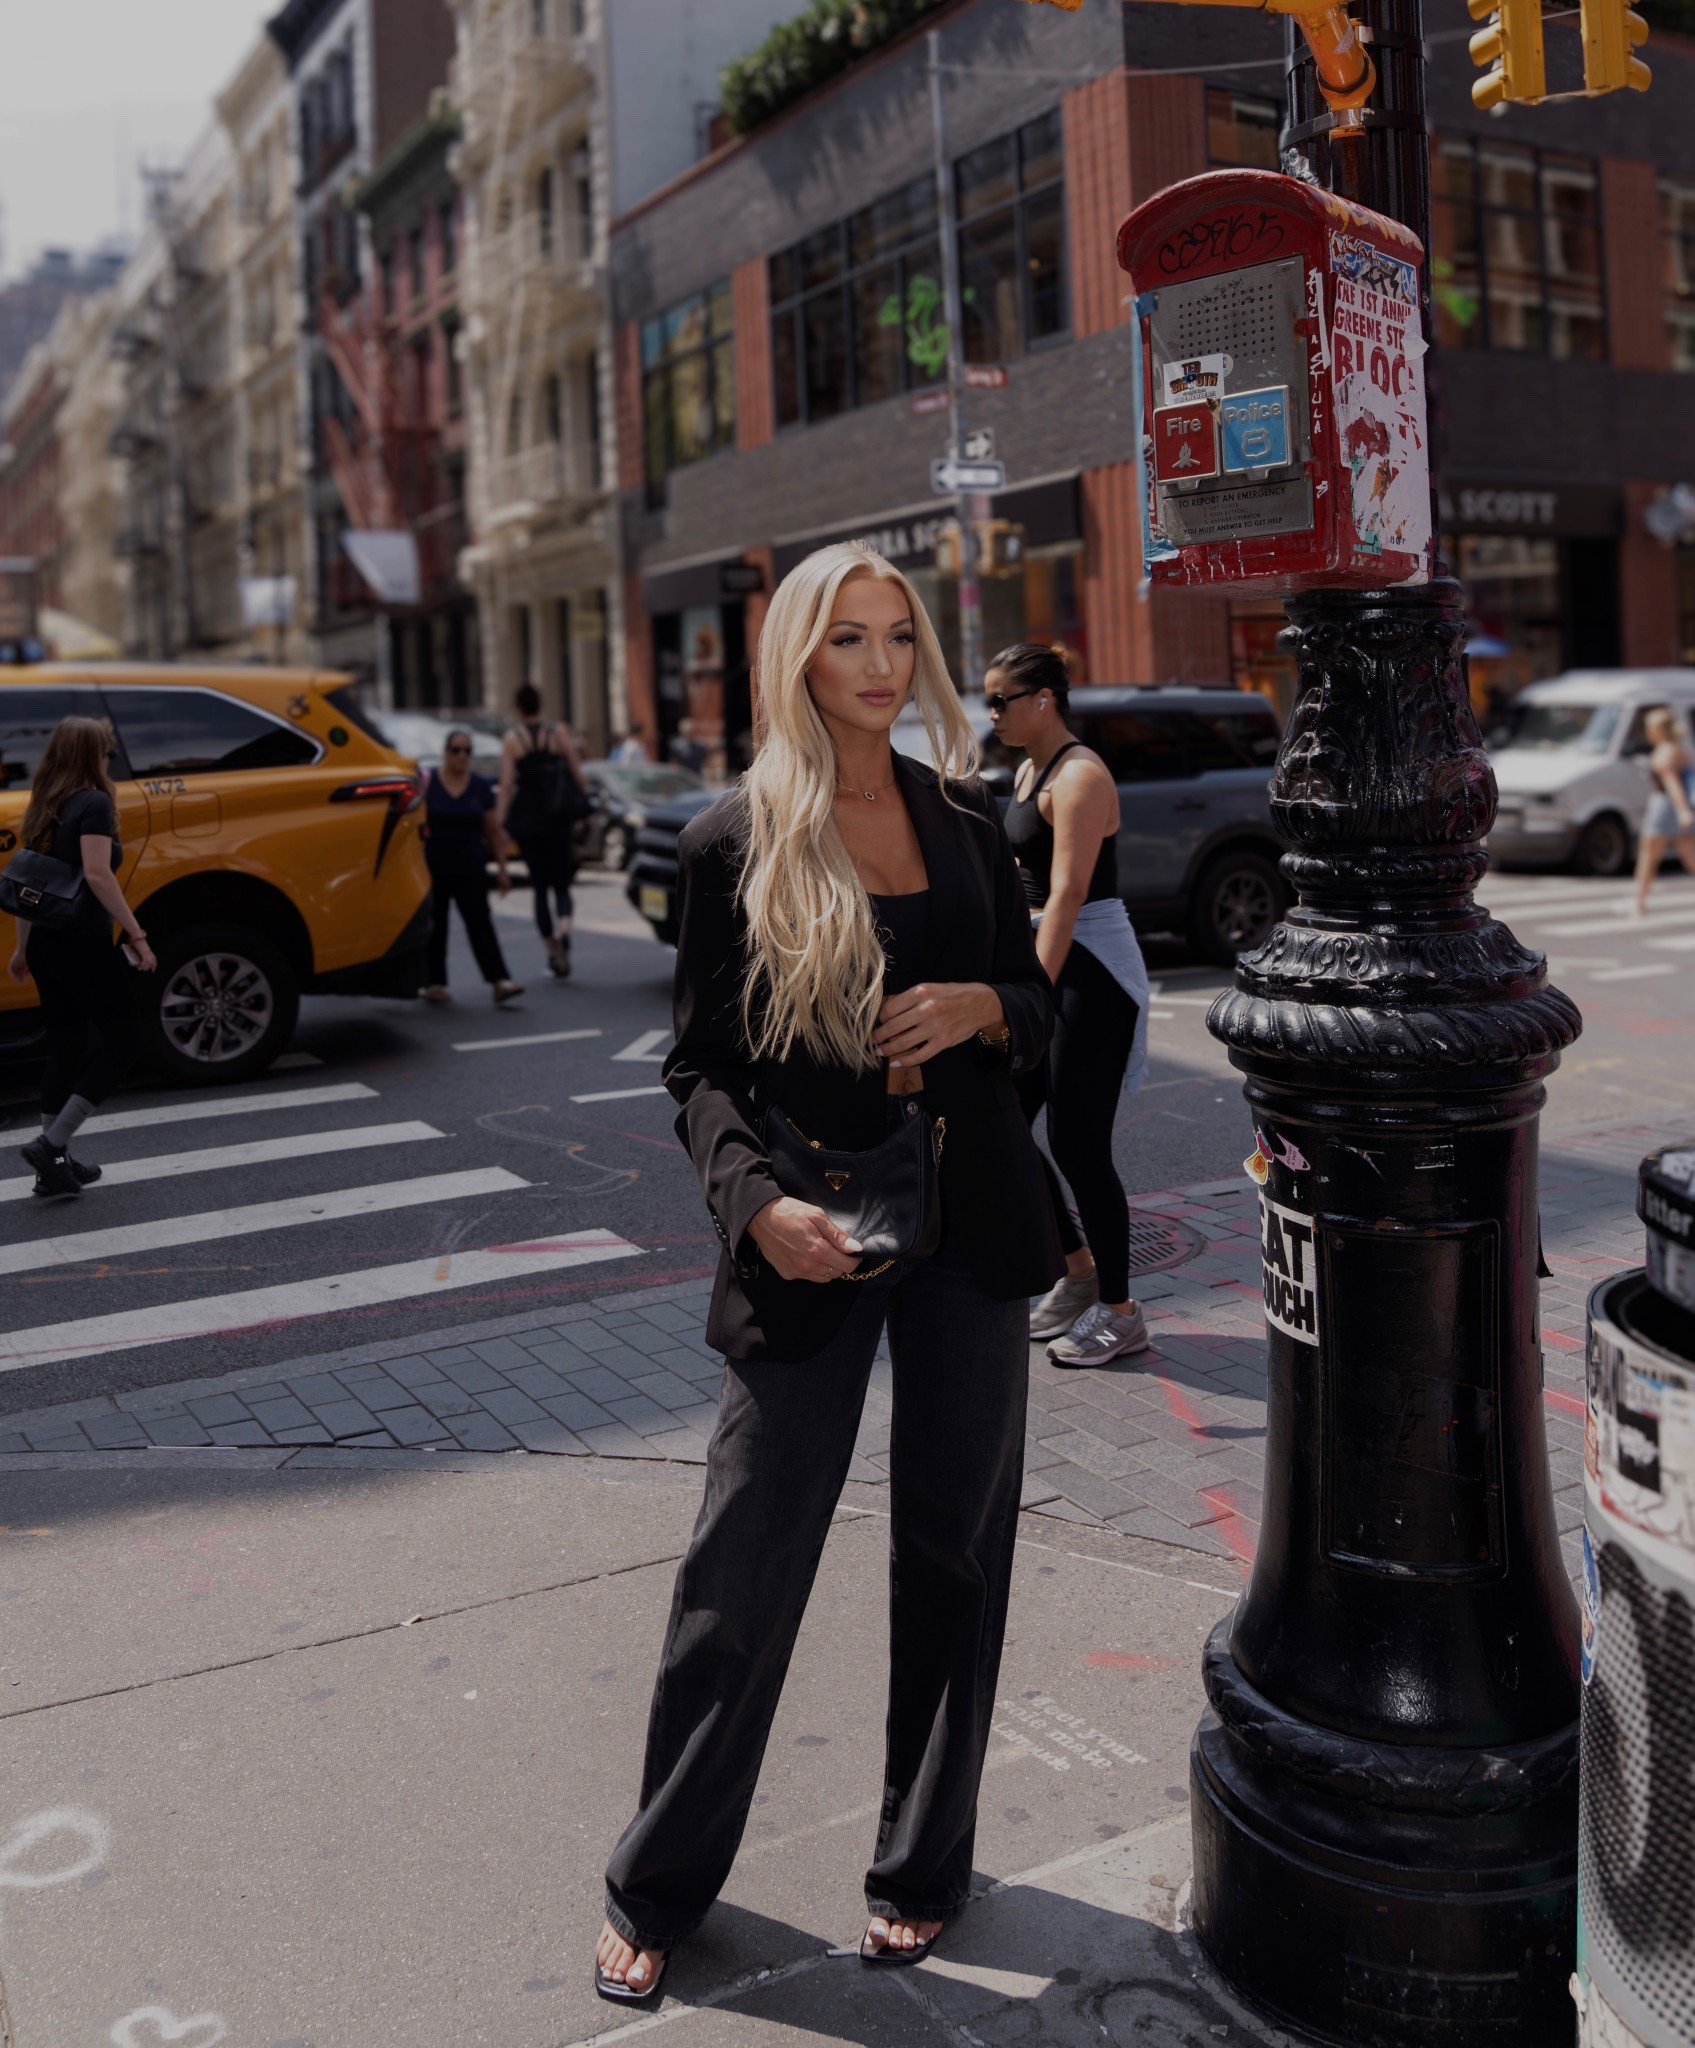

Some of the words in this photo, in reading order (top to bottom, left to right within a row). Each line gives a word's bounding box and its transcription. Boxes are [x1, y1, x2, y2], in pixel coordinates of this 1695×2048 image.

[1337, 280, 1356, 306] THE
[1360, 289, 1378, 314] 1ST
[1334, 306, 1382, 344] GREENE
[1225, 402, 1281, 423] Police
[1166, 416, 1203, 437] Fire
[1178, 500, 1189, 509] TO
[1191, 496, 1219, 507] REPORT
[1222, 493, 1235, 502] AN
[1237, 486, 1287, 501] EMERGENCY
[1183, 527, 1197, 536] YOU
[1198, 525, 1215, 534] MUST
[1217, 523, 1242, 532] ANSWER
[1244, 520, 1253, 529] TO
[1254, 518, 1267, 527] GET
[1267, 516, 1283, 526] HELP
[1233, 513, 1261, 522] OPERATOR
[144, 778, 187, 796] 1K72
[1074, 1728, 1150, 1765] your
